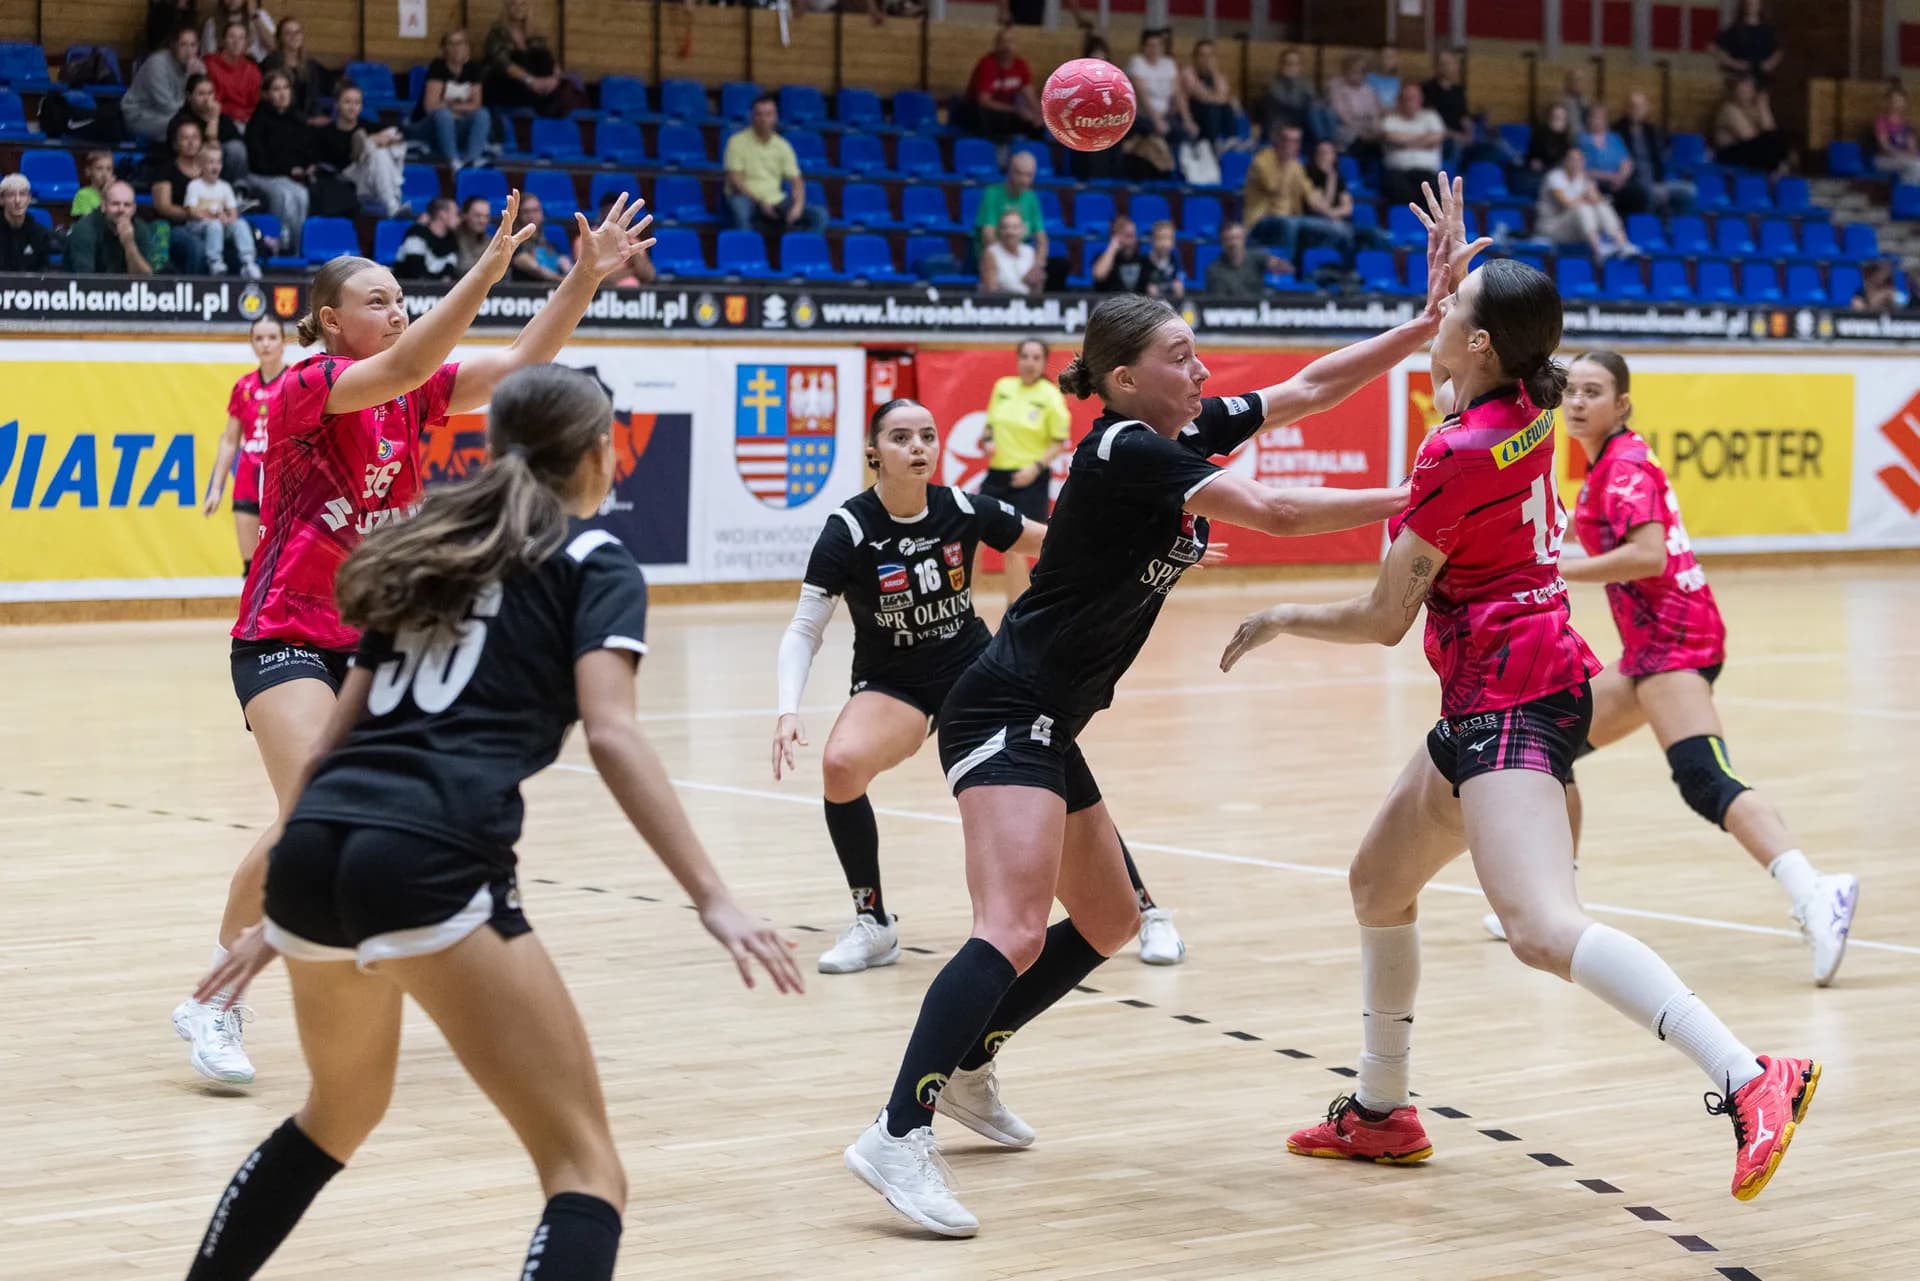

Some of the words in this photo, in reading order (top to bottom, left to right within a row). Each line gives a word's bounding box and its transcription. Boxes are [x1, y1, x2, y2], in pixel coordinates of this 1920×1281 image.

[0, 280, 230, 321] ronahandball.pl
[0, 420, 240, 509] IATA
[1672, 428, 1824, 481] PORTER
[913, 558, 942, 595] 16
[874, 610, 909, 631] SPR
[258, 647, 290, 665] Targi
